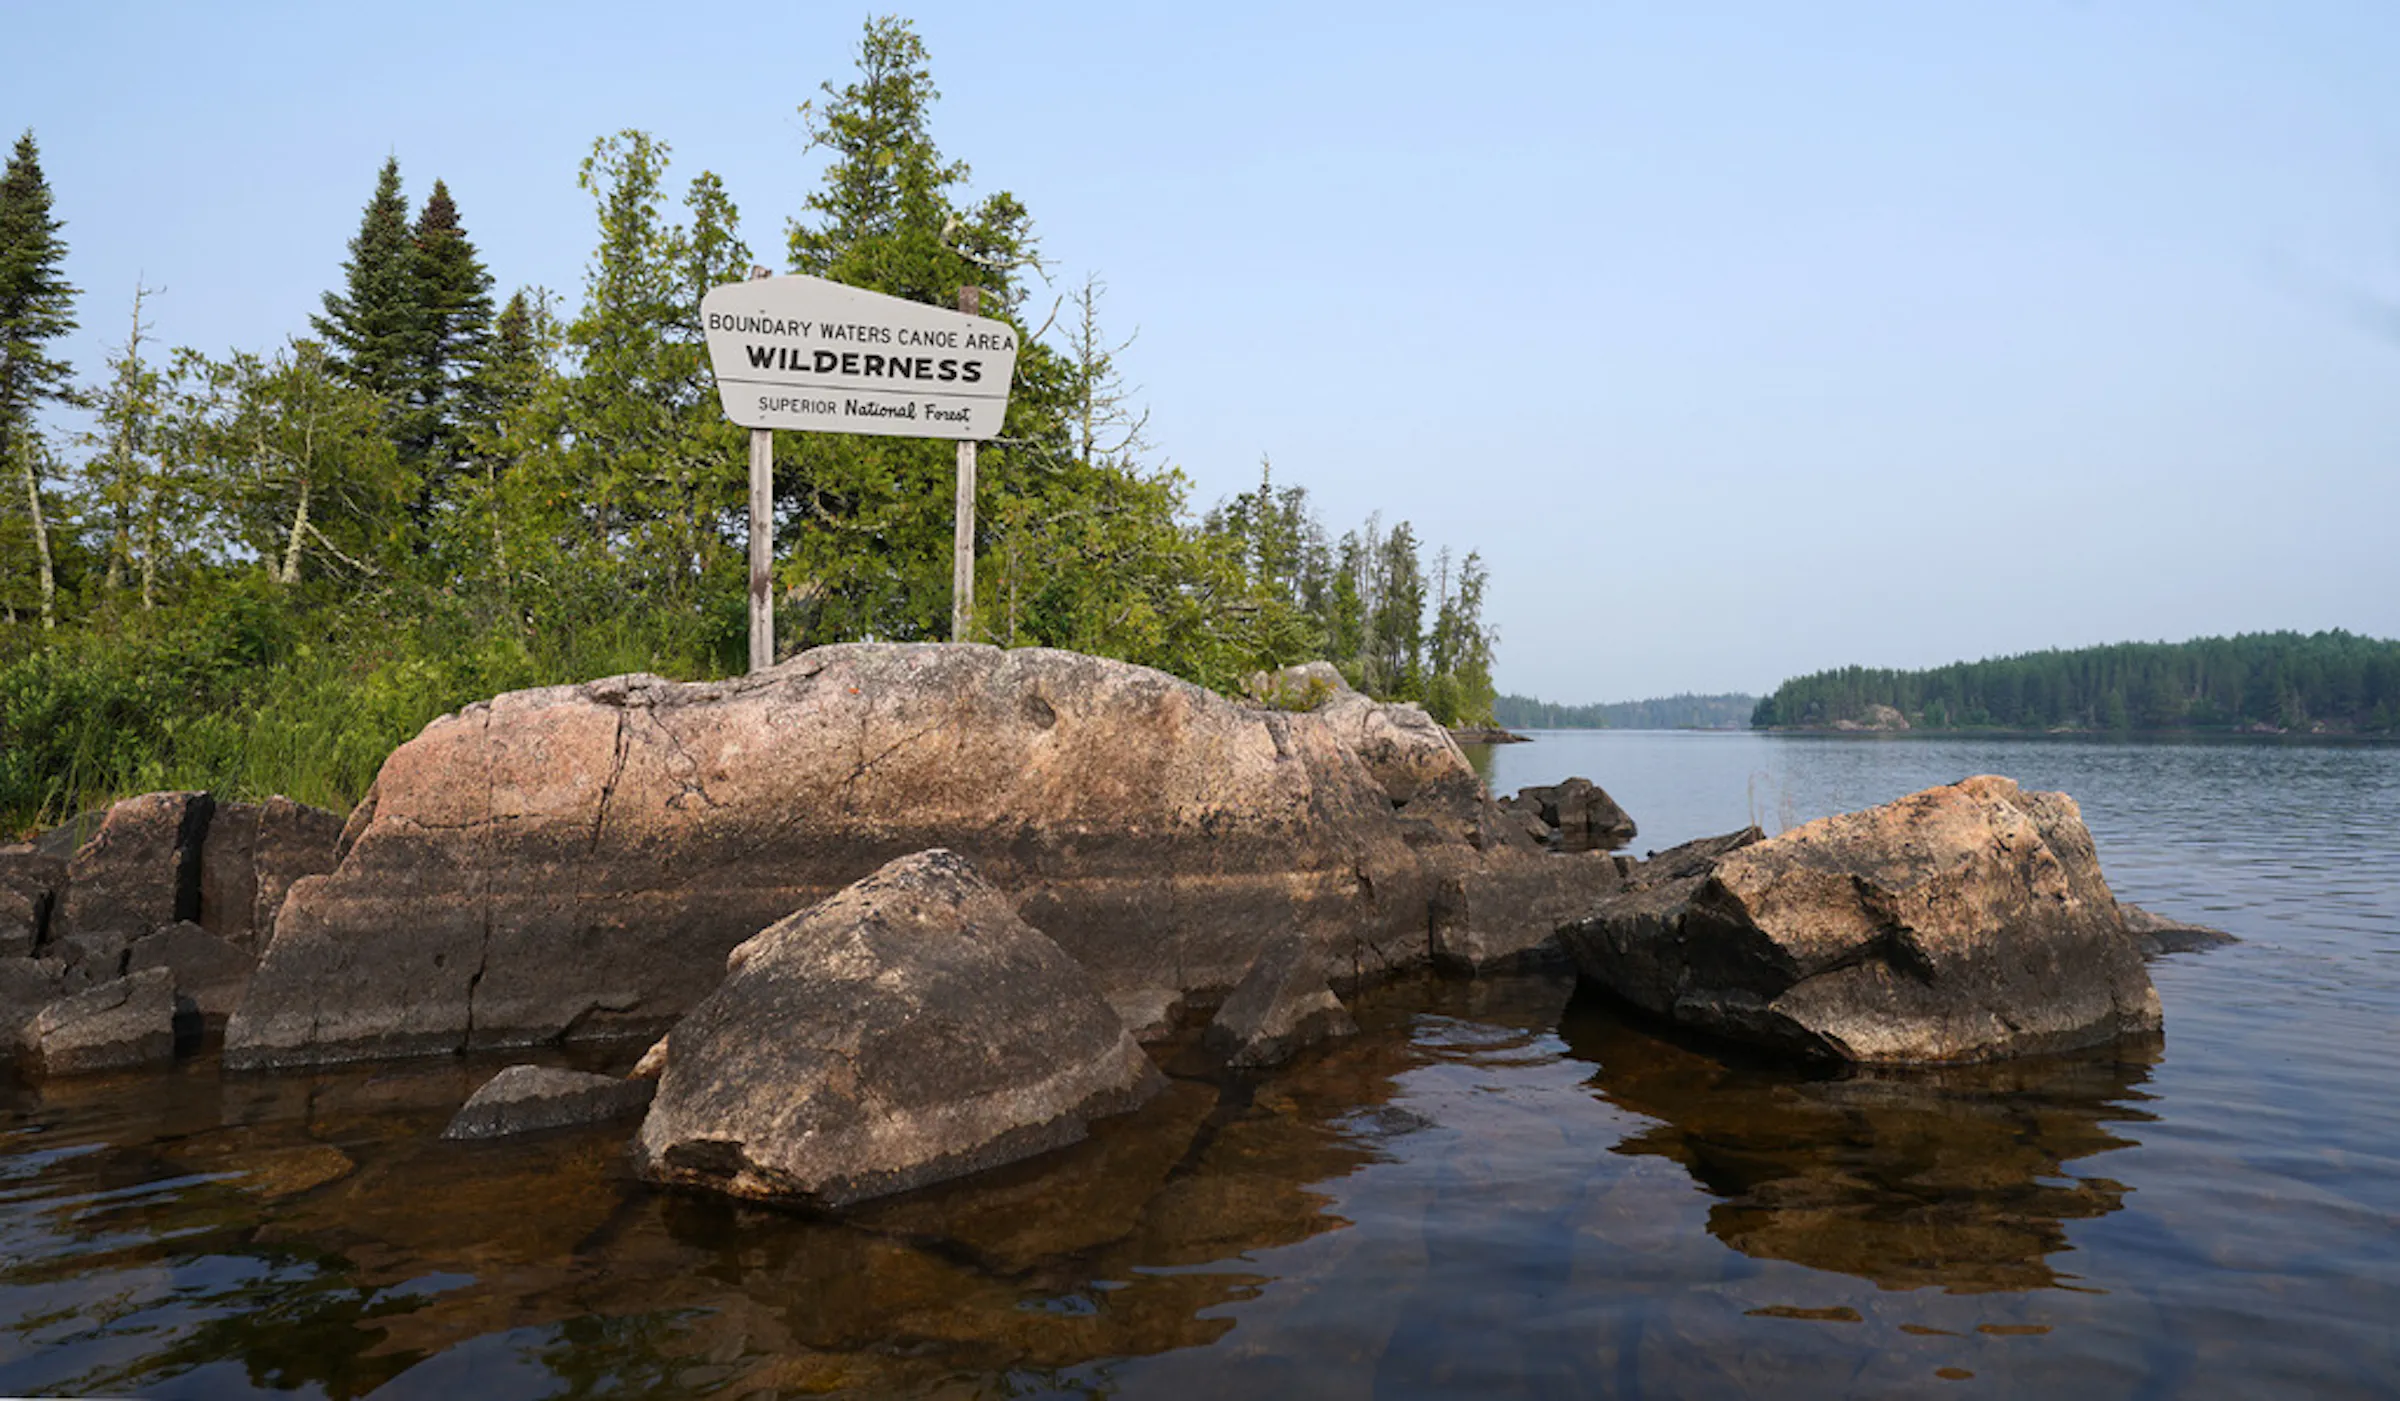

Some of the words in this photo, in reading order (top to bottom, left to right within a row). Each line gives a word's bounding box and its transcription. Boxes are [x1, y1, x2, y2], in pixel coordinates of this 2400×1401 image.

[709, 313, 813, 336] BOUNDARY
[820, 323, 891, 344] WATERS
[898, 328, 958, 349] CANOE
[965, 334, 1015, 351] AREA
[746, 345, 983, 383] WILDERNESS
[758, 396, 837, 415] SUPERIOR
[845, 399, 917, 421] National
[925, 405, 971, 423] Forest
